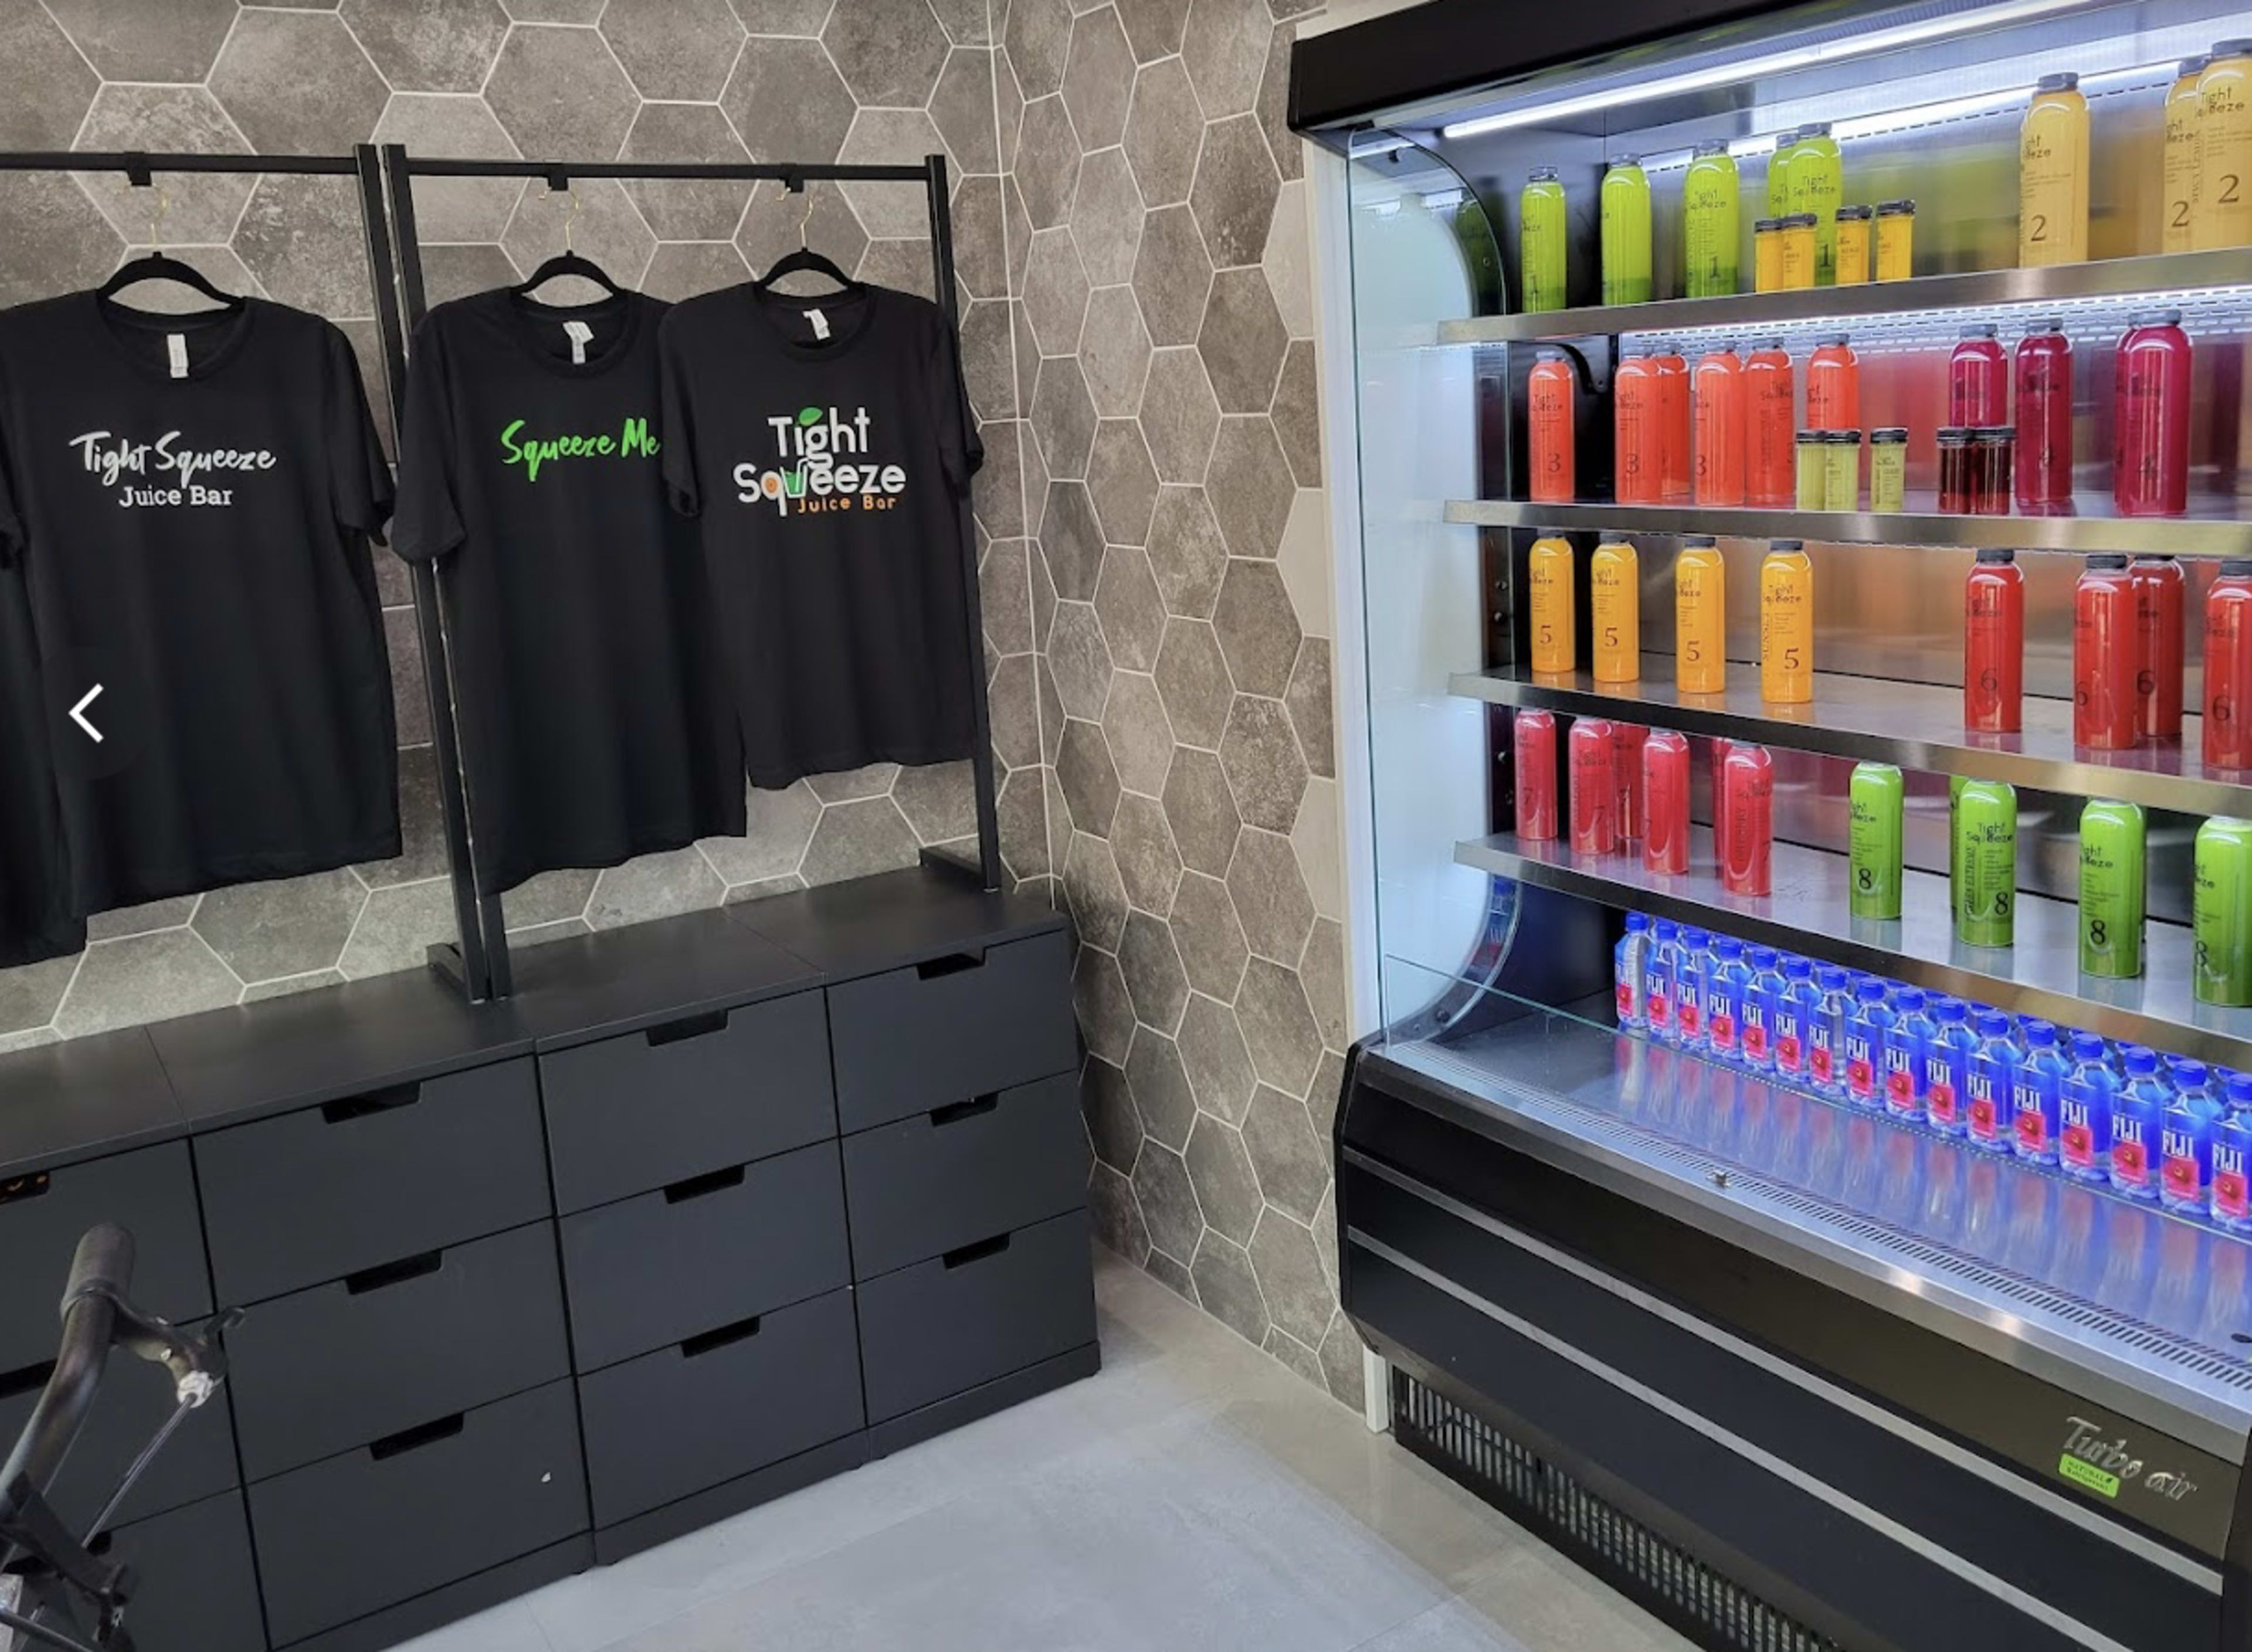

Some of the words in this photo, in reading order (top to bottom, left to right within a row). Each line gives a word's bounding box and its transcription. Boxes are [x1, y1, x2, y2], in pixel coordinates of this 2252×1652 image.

[2218, 174, 2240, 204] 2
[2171, 202, 2190, 228] 2
[2030, 215, 2046, 242] 2
[1710, 256, 1721, 278] 1
[1819, 244, 1830, 267] 1
[501, 419, 618, 481] Squeeze
[622, 417, 661, 459] Me
[768, 405, 870, 470] Tight
[68, 430, 151, 486] Tight
[155, 430, 276, 489] Squeeze
[1548, 453, 1561, 472] 3
[1626, 453, 1639, 474] 3
[1697, 454, 1707, 476] 3
[118, 486, 182, 508] Juice
[189, 486, 232, 506] Bar
[732, 459, 906, 516] Squeeze
[796, 494, 852, 514] Juice
[862, 493, 897, 511] Bar
[1540, 625, 1552, 644] 5
[1605, 627, 1618, 647] 5
[1687, 640, 1700, 662] 5
[1784, 647, 1799, 669] 5
[1980, 668, 1997, 691] 6
[2137, 669, 2155, 695] 6
[2075, 680, 2088, 707] 6
[2212, 694, 2230, 721] 6
[1594, 806, 1605, 824] 7
[1977, 822, 2005, 833] Tight
[1858, 868, 1871, 890] 8
[1995, 891, 2008, 915] 8
[2090, 920, 2106, 945] 8
[2195, 940, 2207, 967] 8
[1709, 994, 1731, 1015] FIJI
[1742, 1003, 1763, 1026] FIJI
[1775, 1014, 1798, 1036] FIJI
[1809, 1025, 1829, 1048] FIJI
[1846, 1037, 1870, 1062] FIJI
[1885, 1047, 1910, 1073] FIJI
[1927, 1059, 1951, 1084] FIJI
[1968, 1073, 1992, 1100] FIJI
[2014, 1085, 2041, 1112] FIJI
[2060, 1099, 2089, 1126] FIJI
[2112, 1115, 2142, 1142] FIJI
[2162, 1130, 2194, 1158] FIJI
[2212, 1144, 2243, 1173] FIJI
[2063, 1416, 2144, 1479] Turbo
[2145, 1471, 2199, 1501] air
